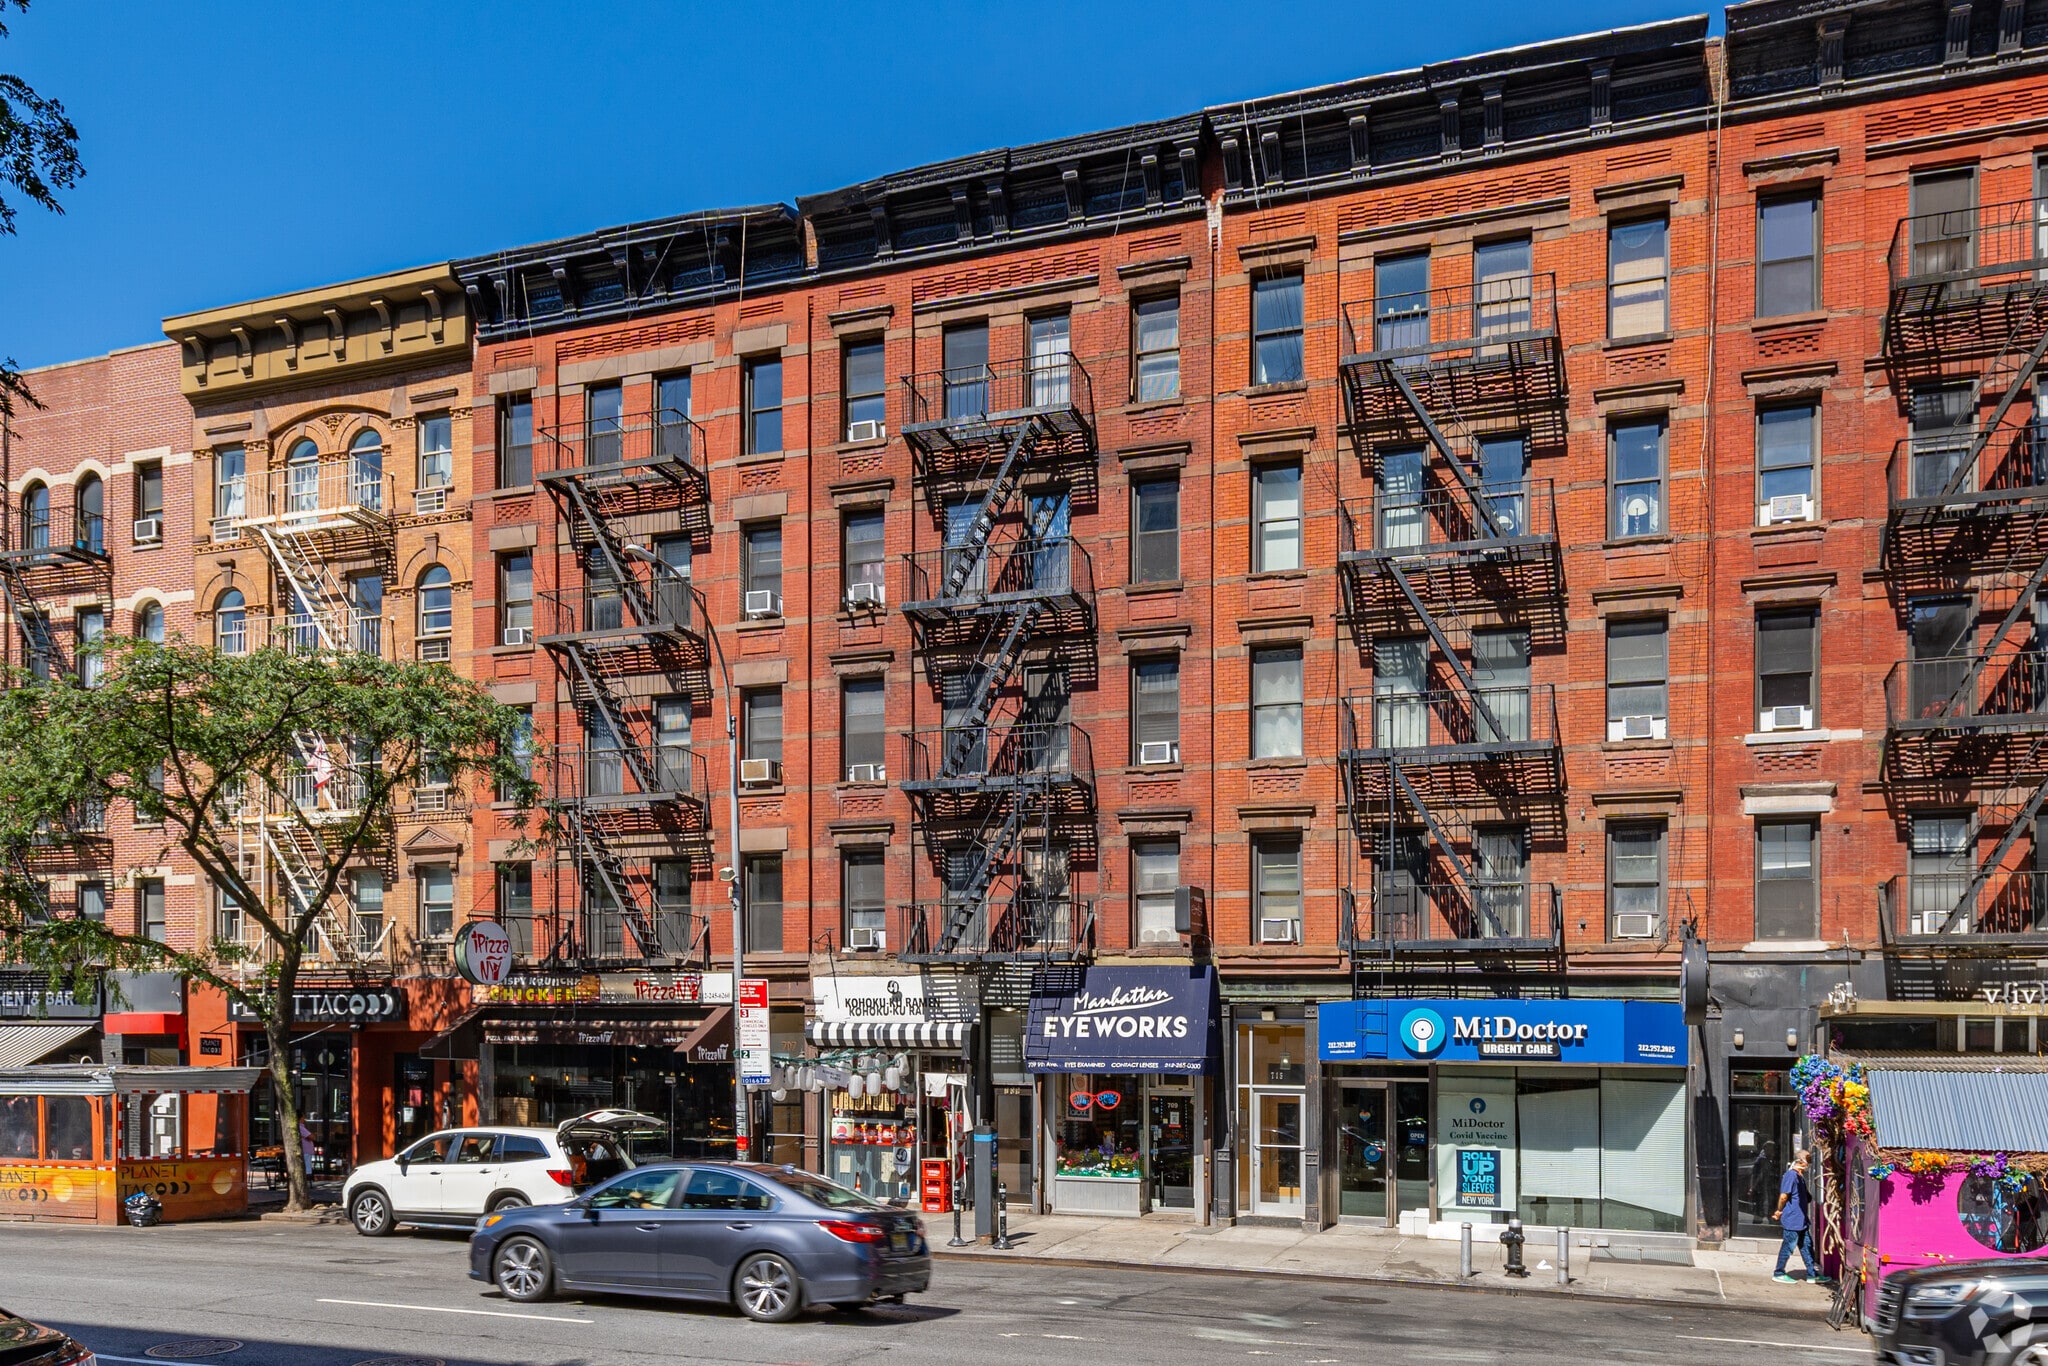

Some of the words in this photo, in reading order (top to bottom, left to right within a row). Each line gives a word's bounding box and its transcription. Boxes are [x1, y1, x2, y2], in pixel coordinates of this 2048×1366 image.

[471, 926, 509, 953] iPizza
[30, 991, 40, 1006] &
[45, 991, 74, 1006] BAR
[490, 988, 578, 1001] CHICKEN
[1073, 986, 1169, 1011] Manhattan
[905, 997, 940, 1008] RAMEN
[1043, 1016, 1188, 1038] EYEWORKS
[1452, 1016, 1588, 1040] MiDoctor
[1482, 1043, 1523, 1054] URGENT
[1526, 1043, 1554, 1055] CARE
[1139, 1061, 1159, 1069] LENSES
[1452, 1118, 1505, 1128] MiDoctor
[1449, 1131, 1474, 1140] Covid
[1476, 1131, 1508, 1140] Vaccine
[1462, 1151, 1495, 1161] ROLL
[121, 1164, 180, 1180] PLANET
[1462, 1160, 1495, 1175] UP
[1462, 1175, 1495, 1183] YOUR
[1462, 1182, 1495, 1194] SLEEVES
[1461, 1196, 1477, 1205] NEW
[1478, 1197, 1495, 1206] YORK
